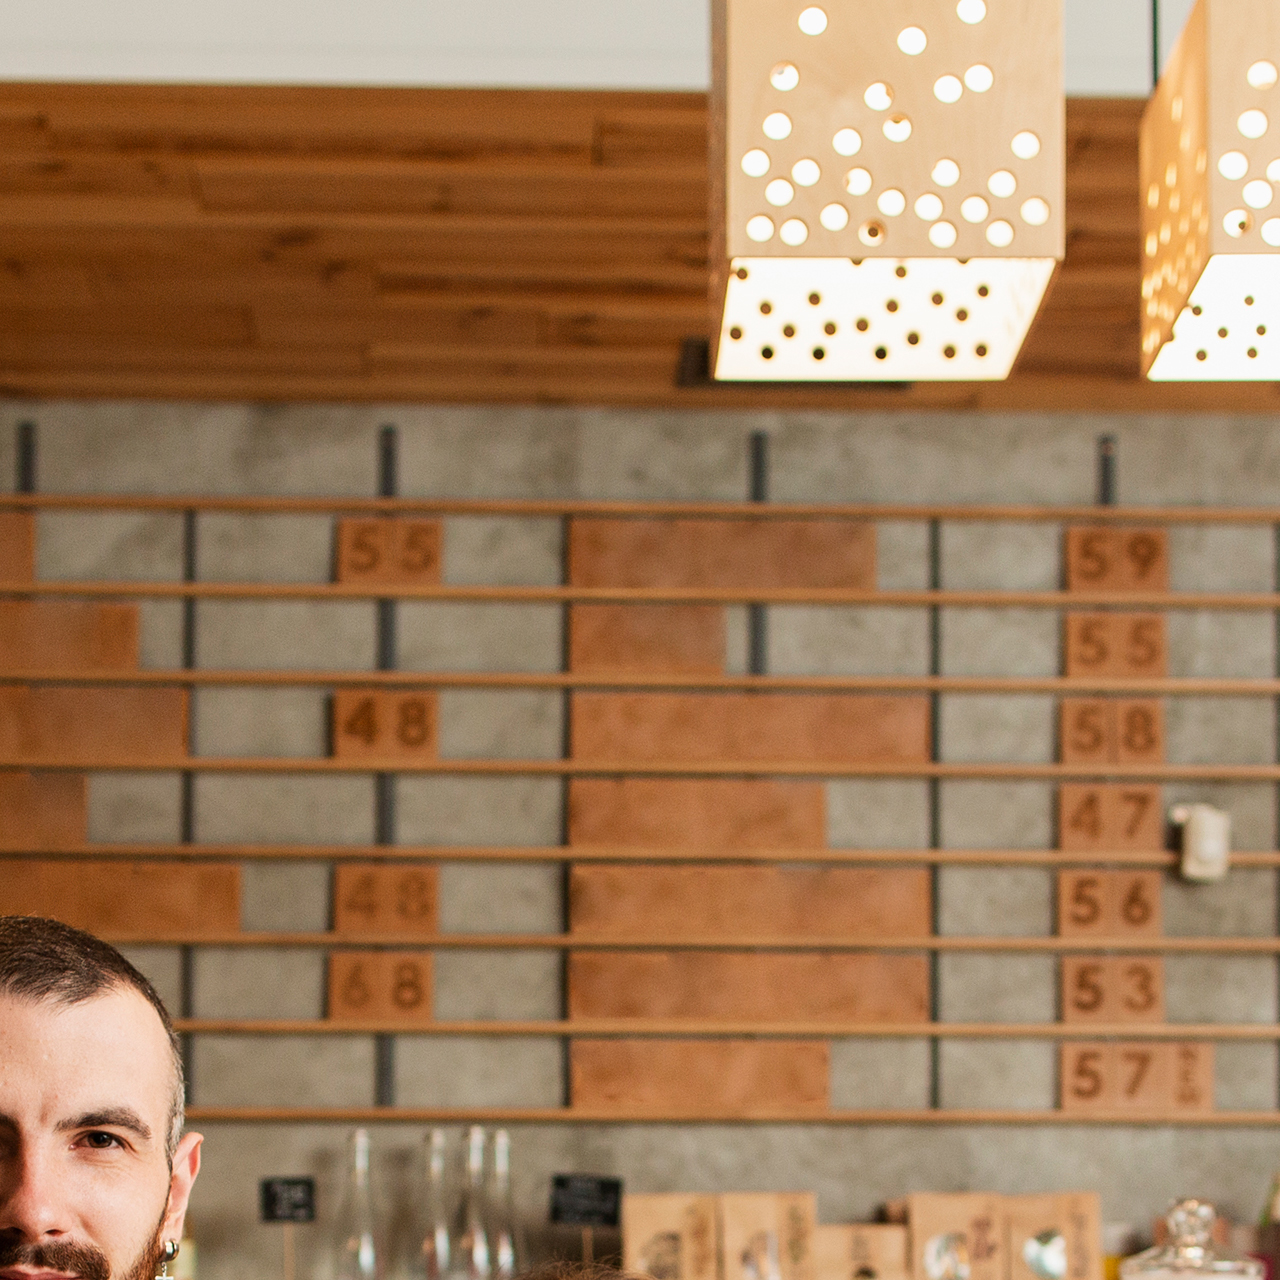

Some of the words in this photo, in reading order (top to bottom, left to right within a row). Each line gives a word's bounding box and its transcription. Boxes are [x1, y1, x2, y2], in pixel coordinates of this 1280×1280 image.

[348, 525, 439, 574] 55
[1078, 533, 1161, 581] 59
[1076, 619, 1158, 668] 55
[343, 697, 430, 748] 48
[1070, 705, 1156, 754] 58
[1070, 791, 1151, 840] 47
[344, 871, 432, 921] 48
[1070, 878, 1154, 927] 56
[339, 960, 424, 1011] 68
[1073, 963, 1157, 1014] 53
[1070, 1051, 1154, 1100] 57
